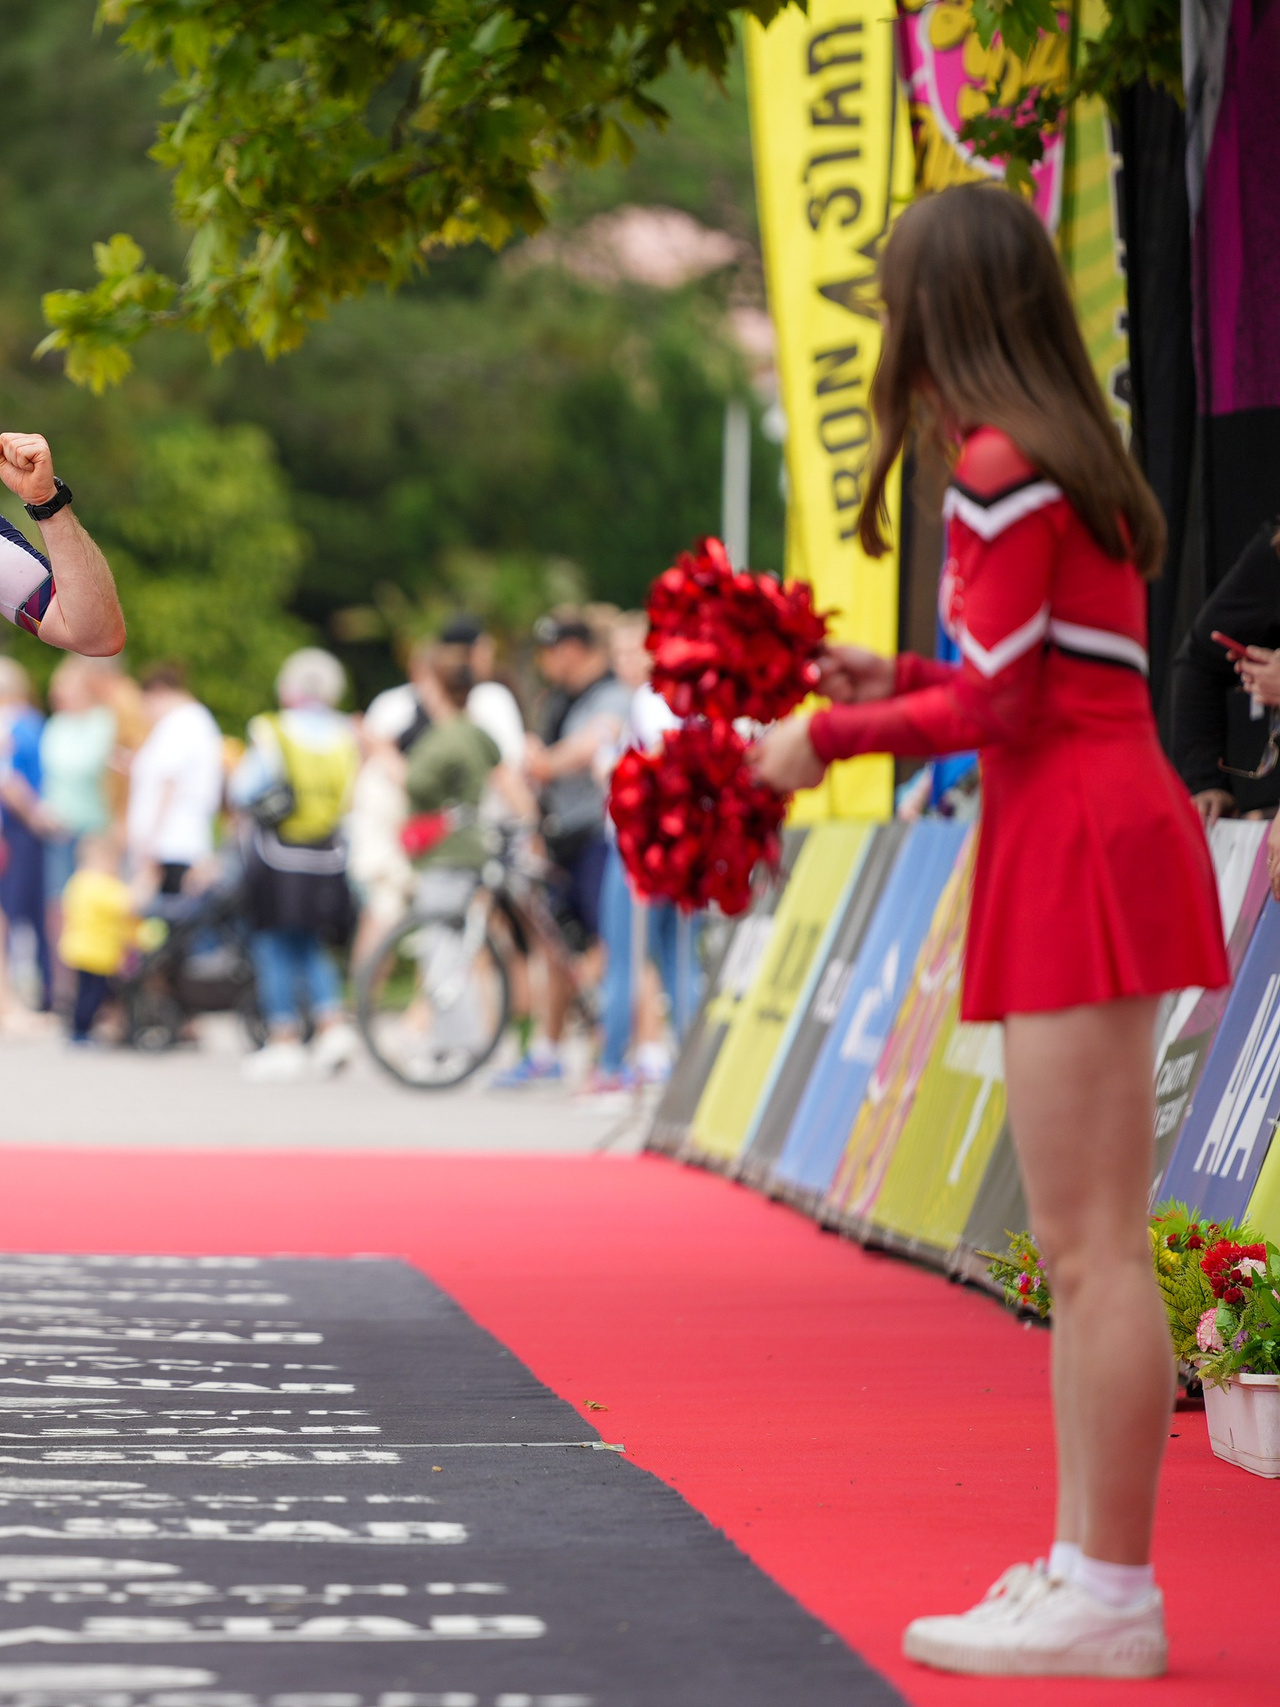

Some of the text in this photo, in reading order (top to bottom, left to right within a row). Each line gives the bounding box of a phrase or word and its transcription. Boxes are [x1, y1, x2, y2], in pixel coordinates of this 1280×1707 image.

[45, 1375, 356, 1392] STAR
[39, 1425, 382, 1435] STAR
[42, 1450, 401, 1462] STAR
[65, 1516, 467, 1541] STAR
